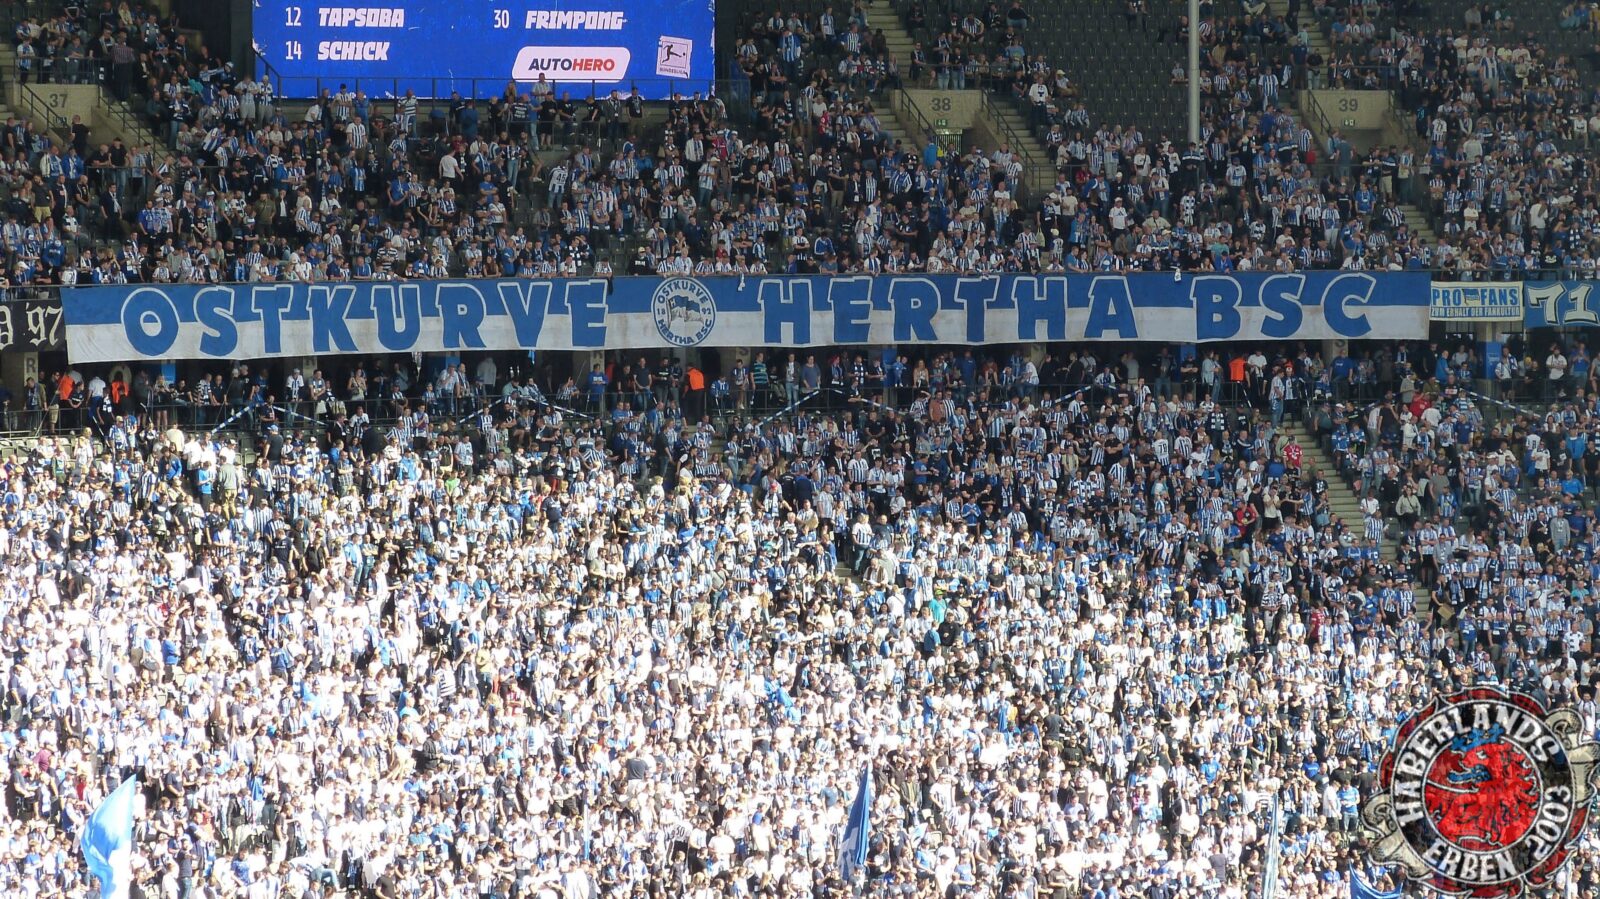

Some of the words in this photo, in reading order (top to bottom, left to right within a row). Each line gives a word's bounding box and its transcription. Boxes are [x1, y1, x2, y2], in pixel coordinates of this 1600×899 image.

[285, 6, 302, 27] 12
[318, 7, 405, 28] TAPSOBA
[493, 9, 510, 29] 30
[525, 10, 624, 30] FRIMPONG
[285, 40, 302, 60] 14
[317, 41, 390, 61] SCHICK
[528, 58, 615, 72] AUTOHERO
[49, 93, 68, 108] 37
[931, 98, 951, 111] 38
[1339, 98, 1358, 111] 39
[657, 280, 708, 304] OSTKURVE
[1432, 288, 1461, 306] PRO
[1480, 288, 1518, 306] FANS
[757, 275, 1138, 345] HERTHA
[1190, 273, 1377, 341] BSC
[1527, 281, 1599, 325] 71
[120, 279, 608, 357] OSTKURVE
[658, 318, 694, 344] HERTHA
[695, 319, 712, 340] BSC
[26, 357, 36, 373] R
